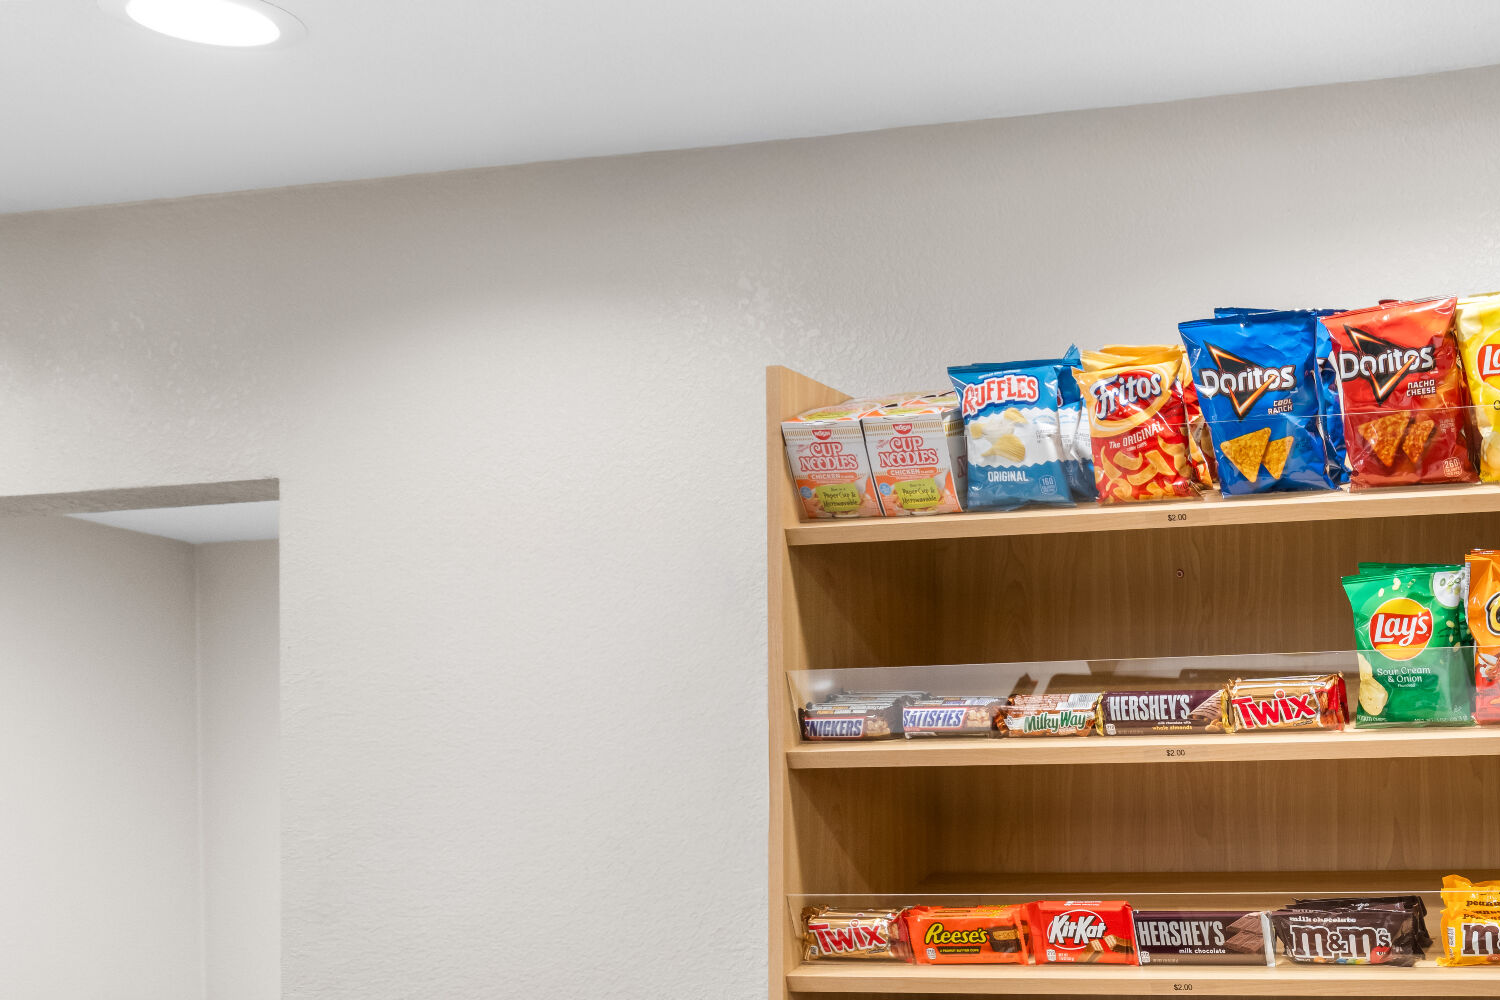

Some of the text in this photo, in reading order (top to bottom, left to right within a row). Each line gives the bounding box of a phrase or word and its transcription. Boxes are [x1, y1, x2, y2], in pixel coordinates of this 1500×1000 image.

[1340, 347, 1434, 380] Doritos
[1201, 366, 1296, 396] Doritos
[1407, 379, 1435, 389] NACHO
[962, 375, 1038, 416] RUFFLES
[1090, 371, 1162, 420] Fritos
[1406, 386, 1436, 397] CHEESE
[1267, 404, 1293, 415] RANCH
[1273, 398, 1292, 407] COOL
[1123, 421, 1164, 447] ORIGINAL
[810, 442, 843, 457] CUP
[889, 436, 923, 452] CUP
[799, 454, 859, 472] NOODLES
[878, 448, 939, 468] NOODLES
[987, 470, 1029, 483] ORIGINAL
[1167, 513, 1187, 522] $2.00
[1374, 611, 1429, 648] Lay's
[1376, 666, 1431, 676] Sour Cream
[1387, 674, 1423, 683] & Onion
[1109, 694, 1190, 721] HERSHEY'S
[1231, 688, 1316, 729] Twix
[903, 708, 963, 728] SATISFIES
[1024, 710, 1087, 733] Milky Way
[804, 719, 863, 737] SNICKERS
[1166, 749, 1186, 757] $2.00
[1289, 915, 1312, 923] milk
[808, 919, 888, 954] Twix
[925, 922, 988, 945] Reese's
[1137, 920, 1225, 946] HERSHEY'S
[1173, 983, 1193, 992] $2.00
